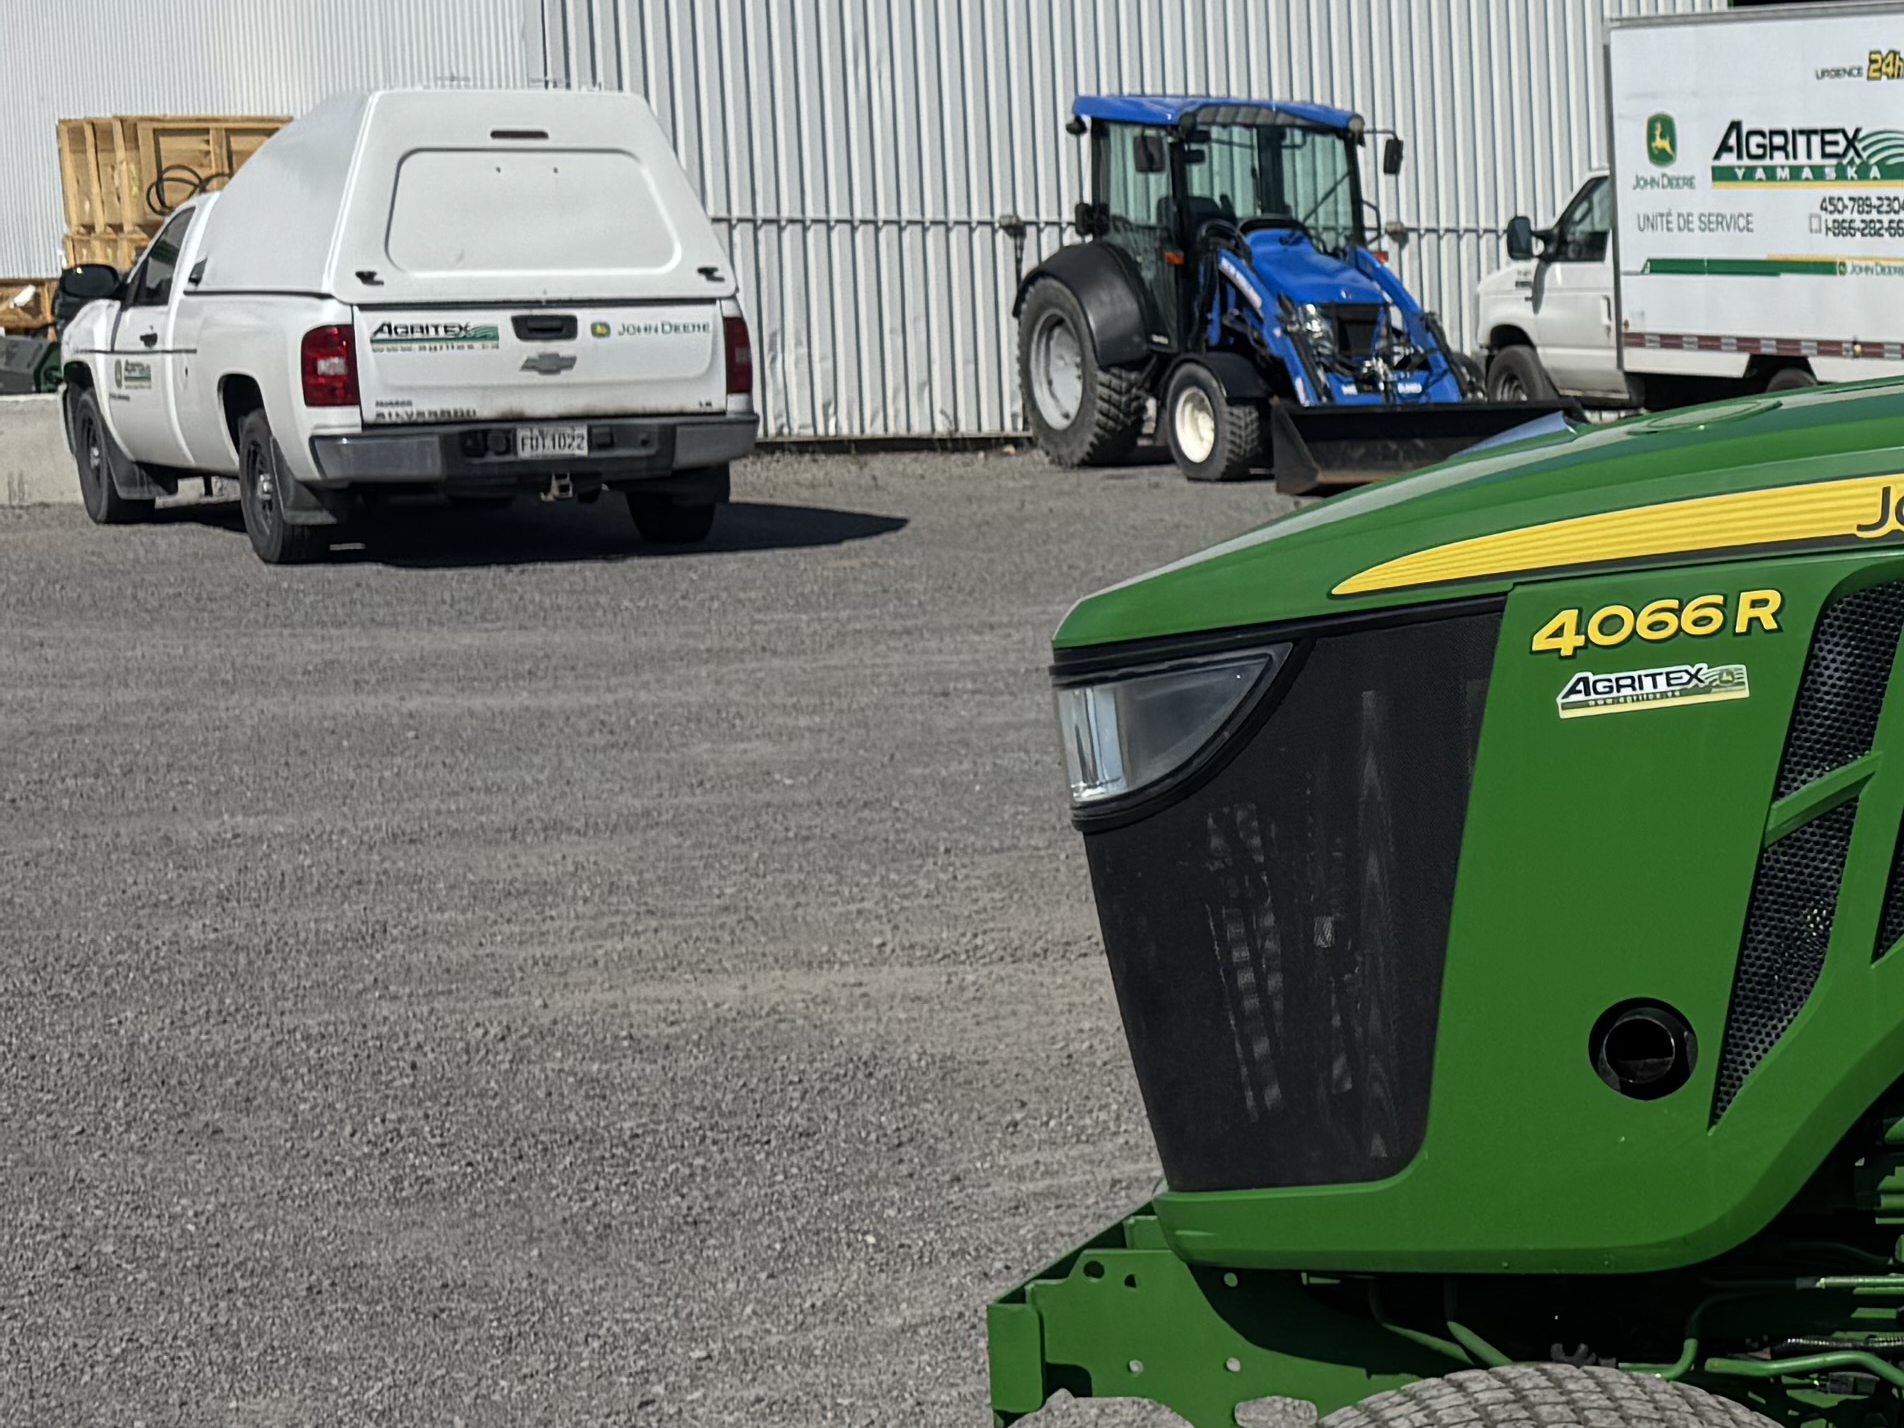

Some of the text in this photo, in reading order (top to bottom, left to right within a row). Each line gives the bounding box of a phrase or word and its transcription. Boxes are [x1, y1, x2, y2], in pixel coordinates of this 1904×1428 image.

[1867, 50, 1904, 81] 24h
[1713, 120, 1862, 161] AGRITEX
[1632, 173, 1696, 190] JOHN DEERE
[1735, 167, 1881, 181] YAMASKA
[1637, 208, 1754, 233] UNITÉ DE SERVICE
[373, 321, 471, 339] AGRITEX
[618, 322, 710, 336] JOHN DEERE
[1531, 589, 1782, 656] 4066 R
[1561, 666, 1707, 700] AGRITEX
